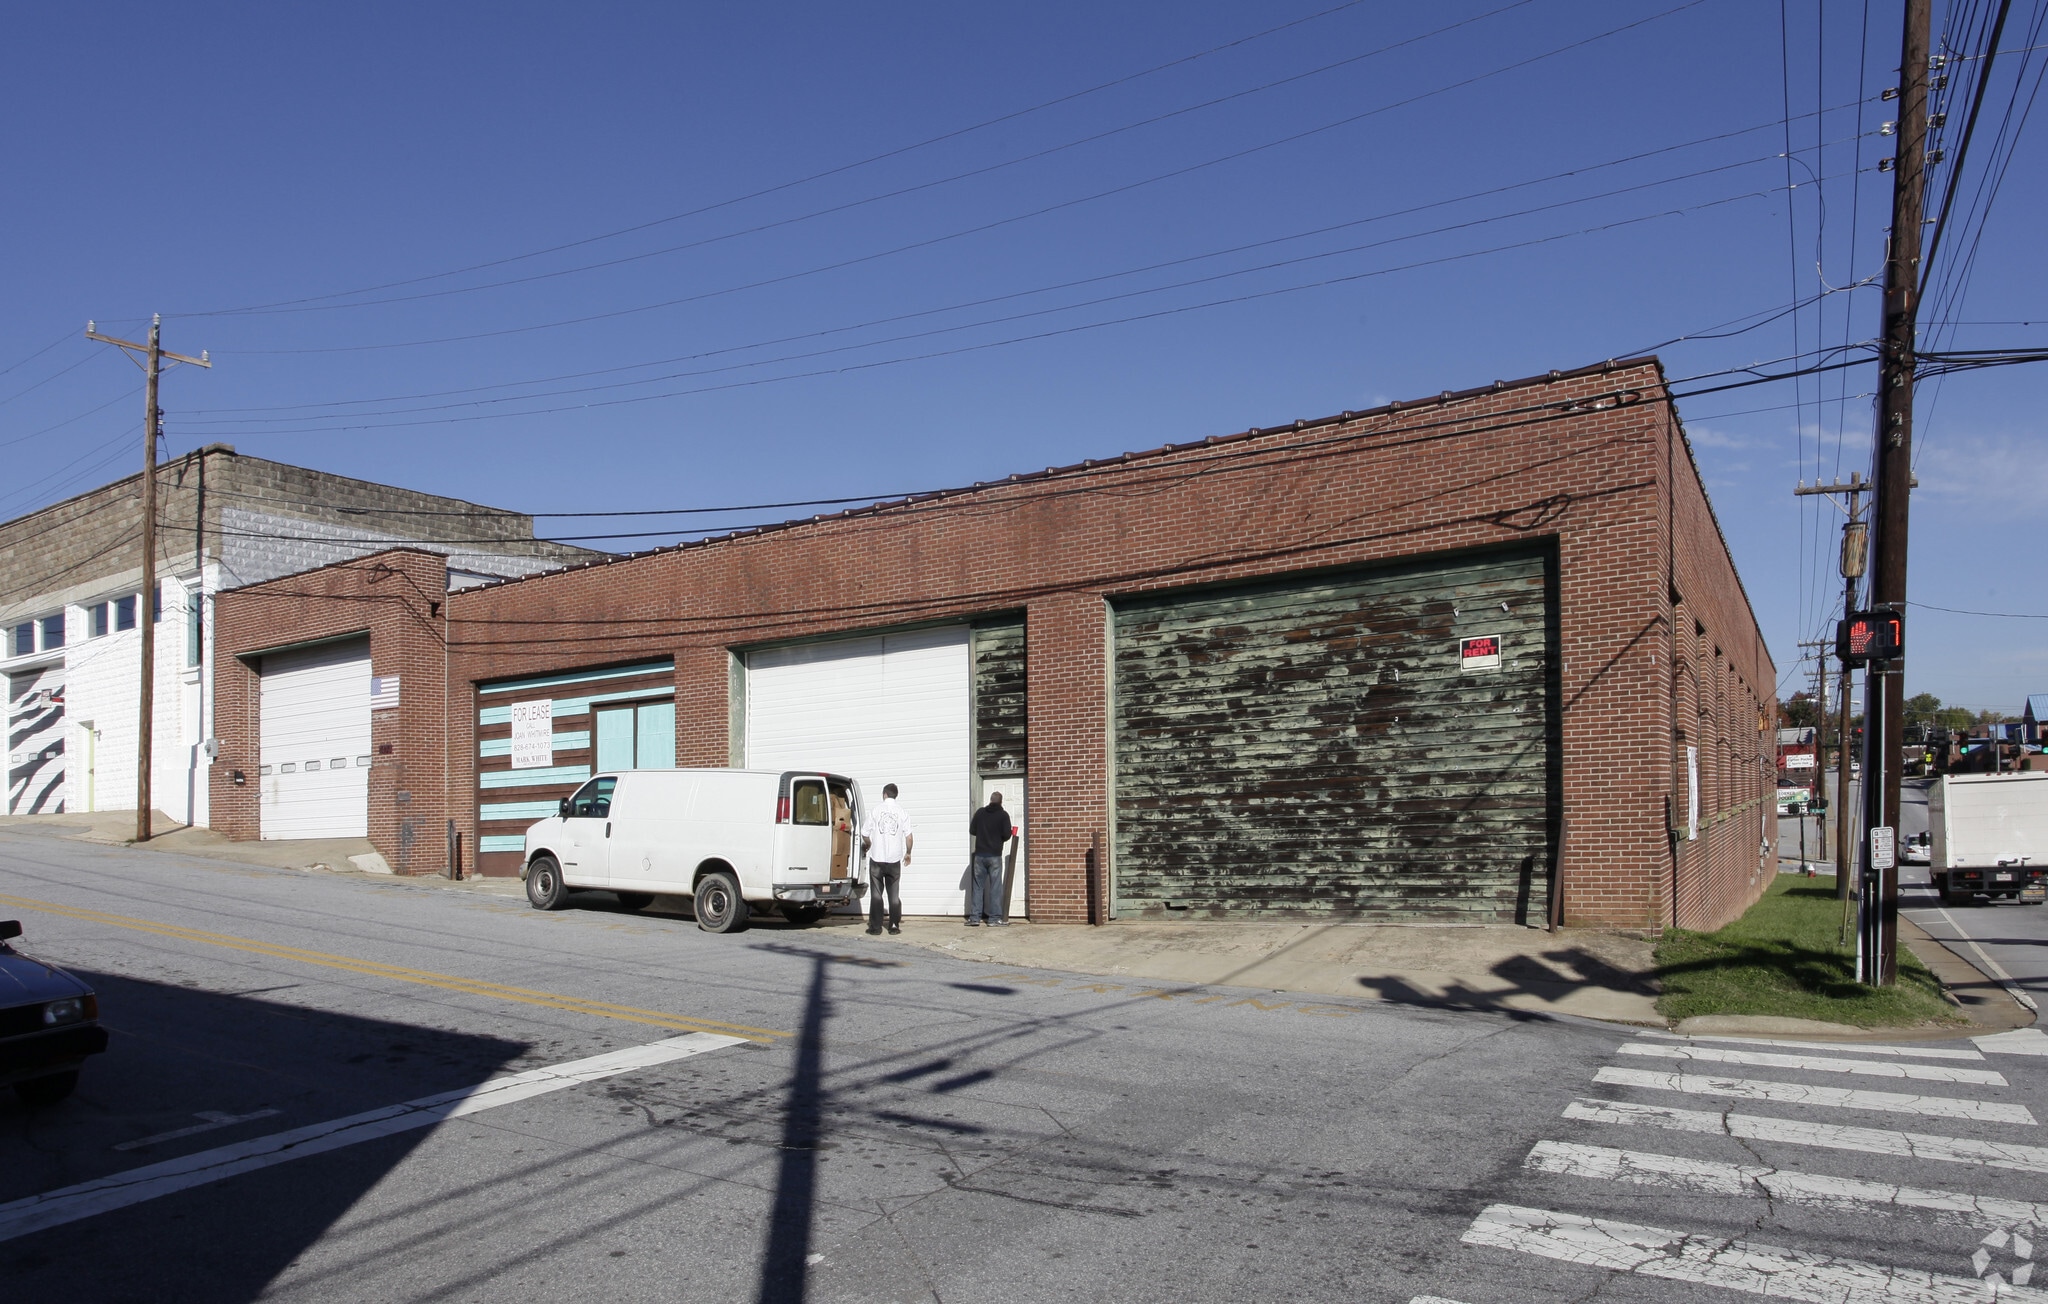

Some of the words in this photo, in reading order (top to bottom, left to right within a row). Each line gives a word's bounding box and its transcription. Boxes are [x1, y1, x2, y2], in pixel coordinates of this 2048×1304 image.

[1888, 619, 1900, 647] 7
[1469, 638, 1491, 649] FOR
[1463, 646, 1497, 658] RENT
[513, 706, 527, 722] FOR
[528, 704, 550, 720] LEASE
[997, 759, 1014, 770] 147
